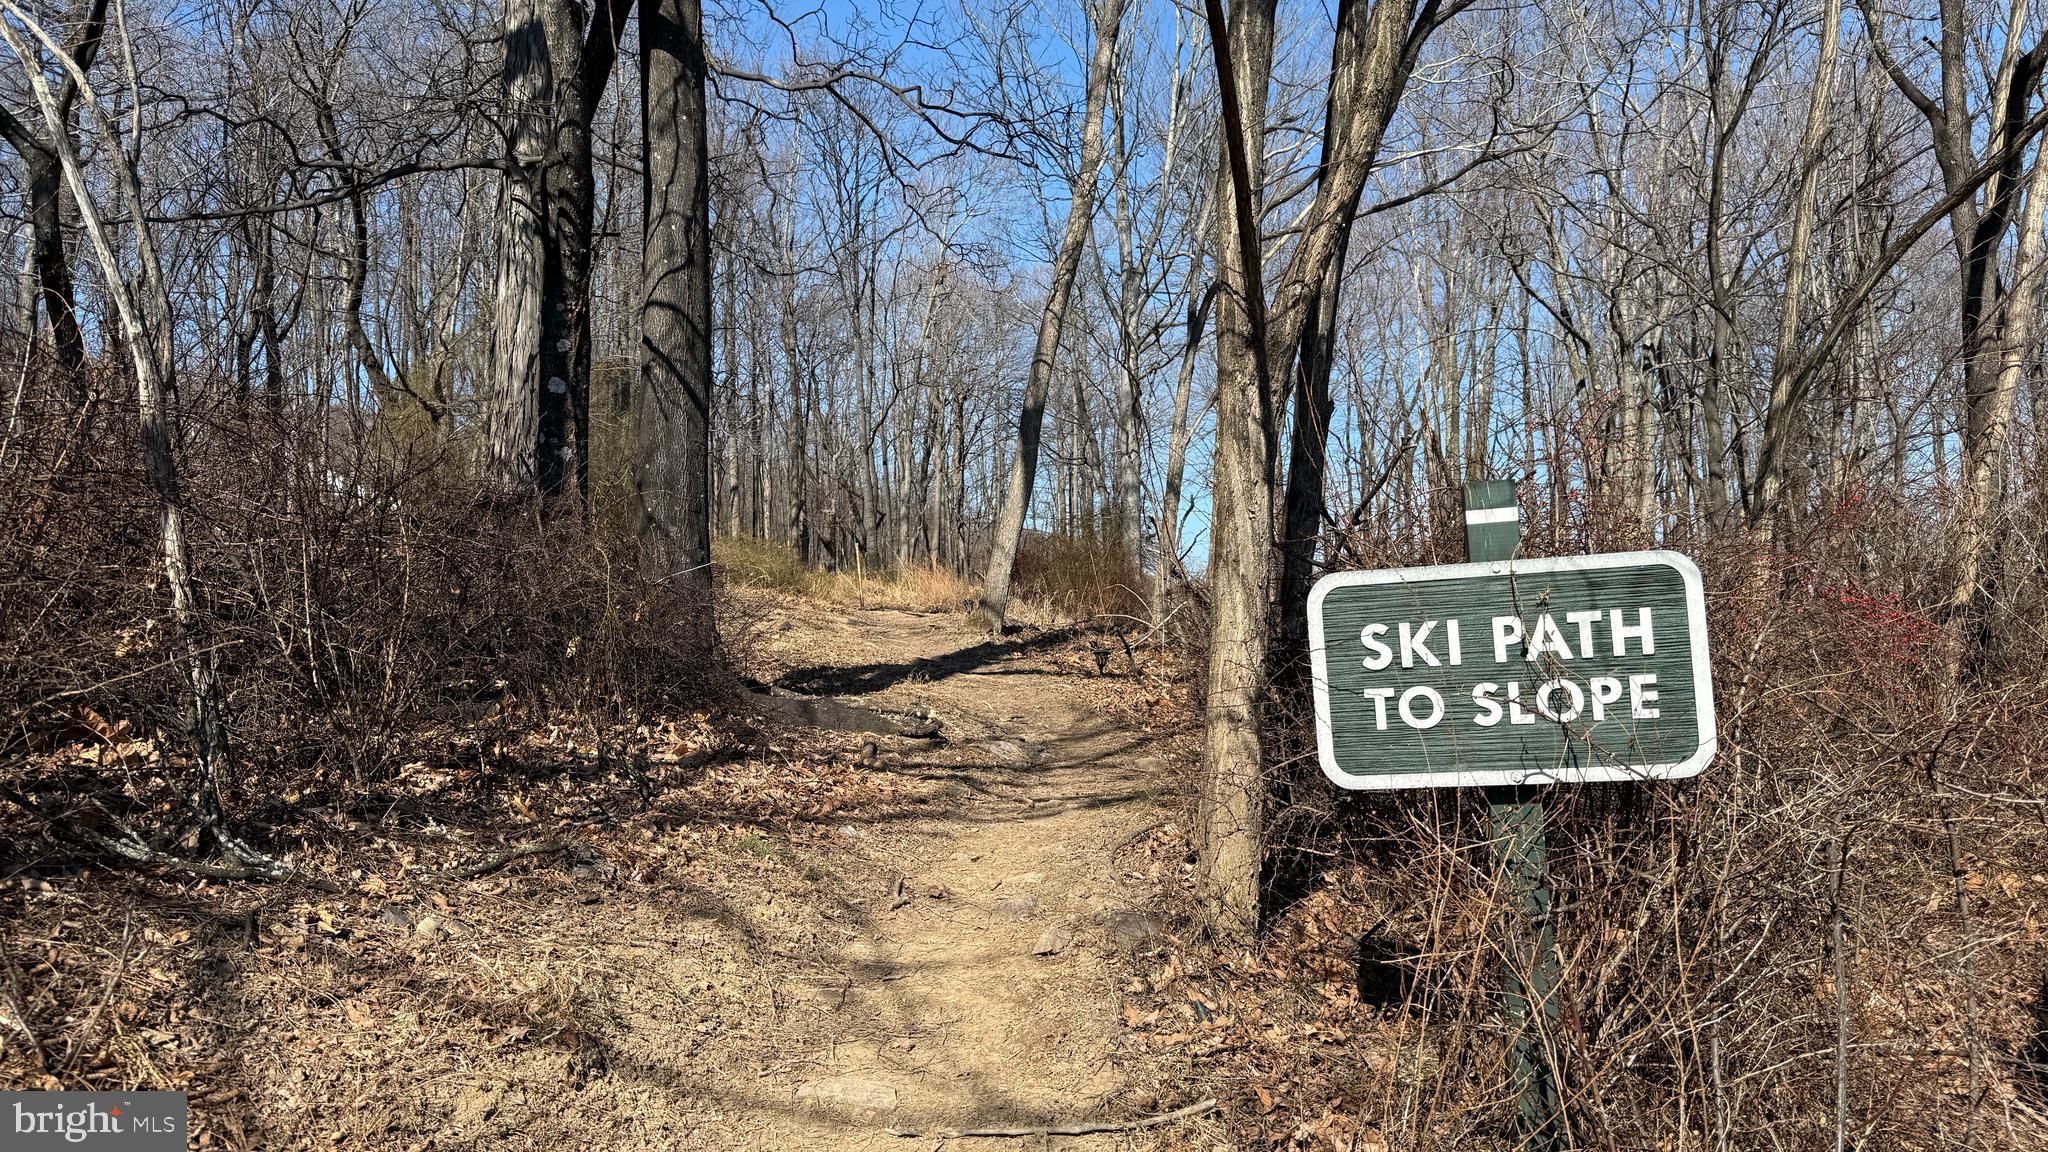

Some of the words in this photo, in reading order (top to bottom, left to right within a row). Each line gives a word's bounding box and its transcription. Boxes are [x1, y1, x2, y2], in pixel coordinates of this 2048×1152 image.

[1360, 619, 1462, 671] SKI
[1492, 607, 1656, 663] PATH
[1363, 685, 1445, 731] TO
[1472, 674, 1660, 727] SLOPE
